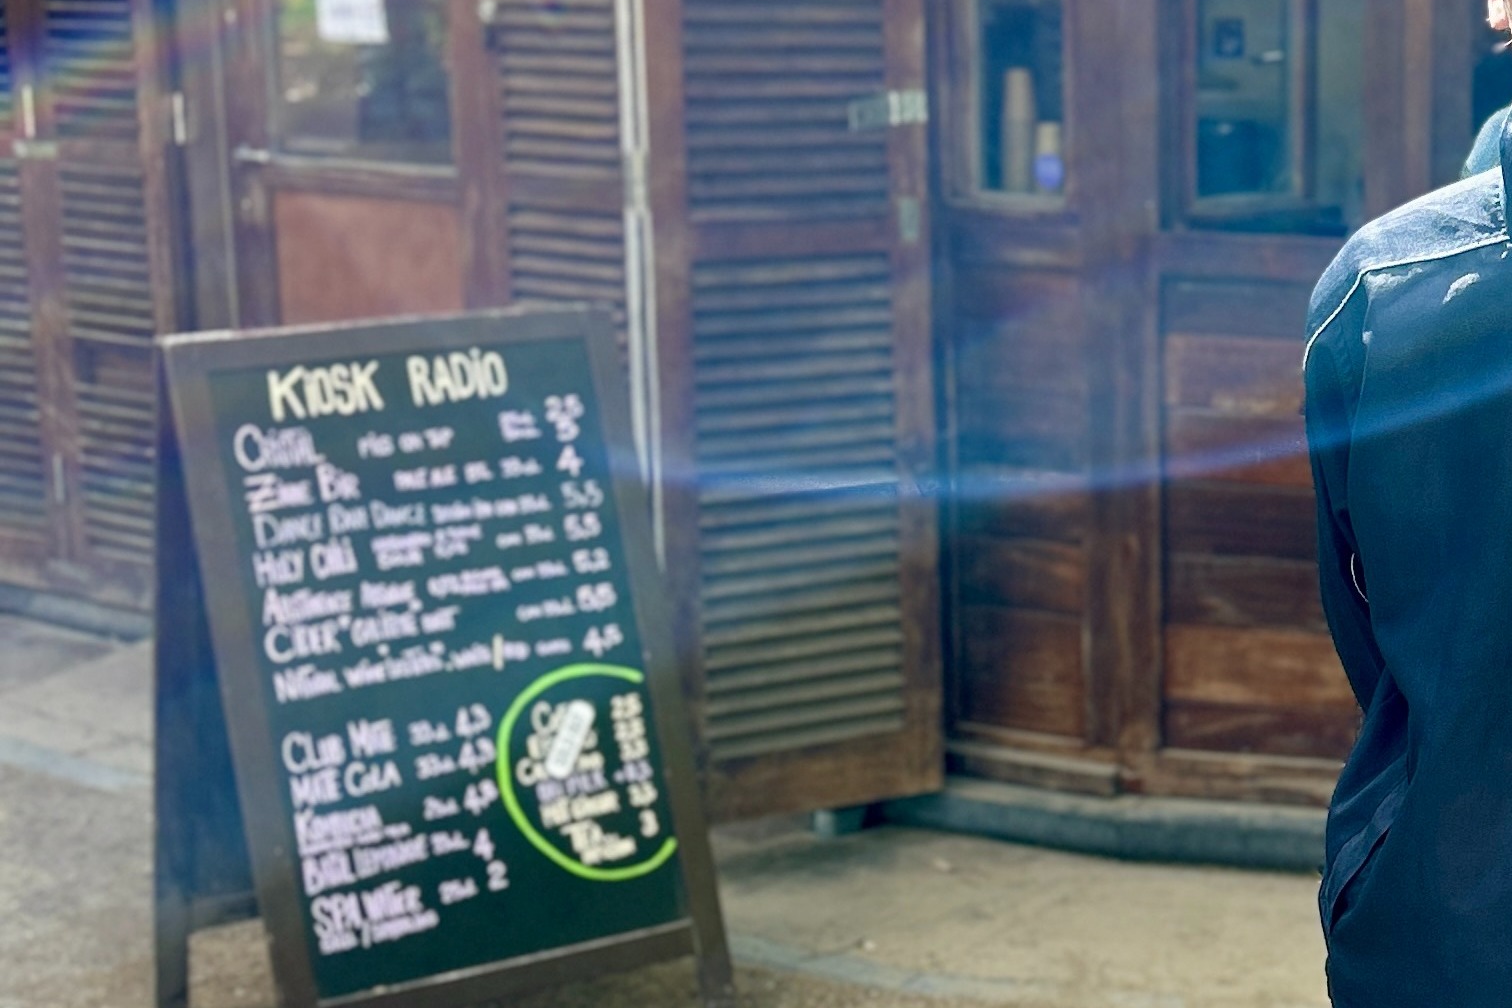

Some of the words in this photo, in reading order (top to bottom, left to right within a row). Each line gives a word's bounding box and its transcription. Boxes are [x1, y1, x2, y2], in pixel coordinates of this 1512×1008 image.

[556, 444, 584, 477] 4
[473, 827, 495, 861] 4
[486, 859, 509, 892] 2
